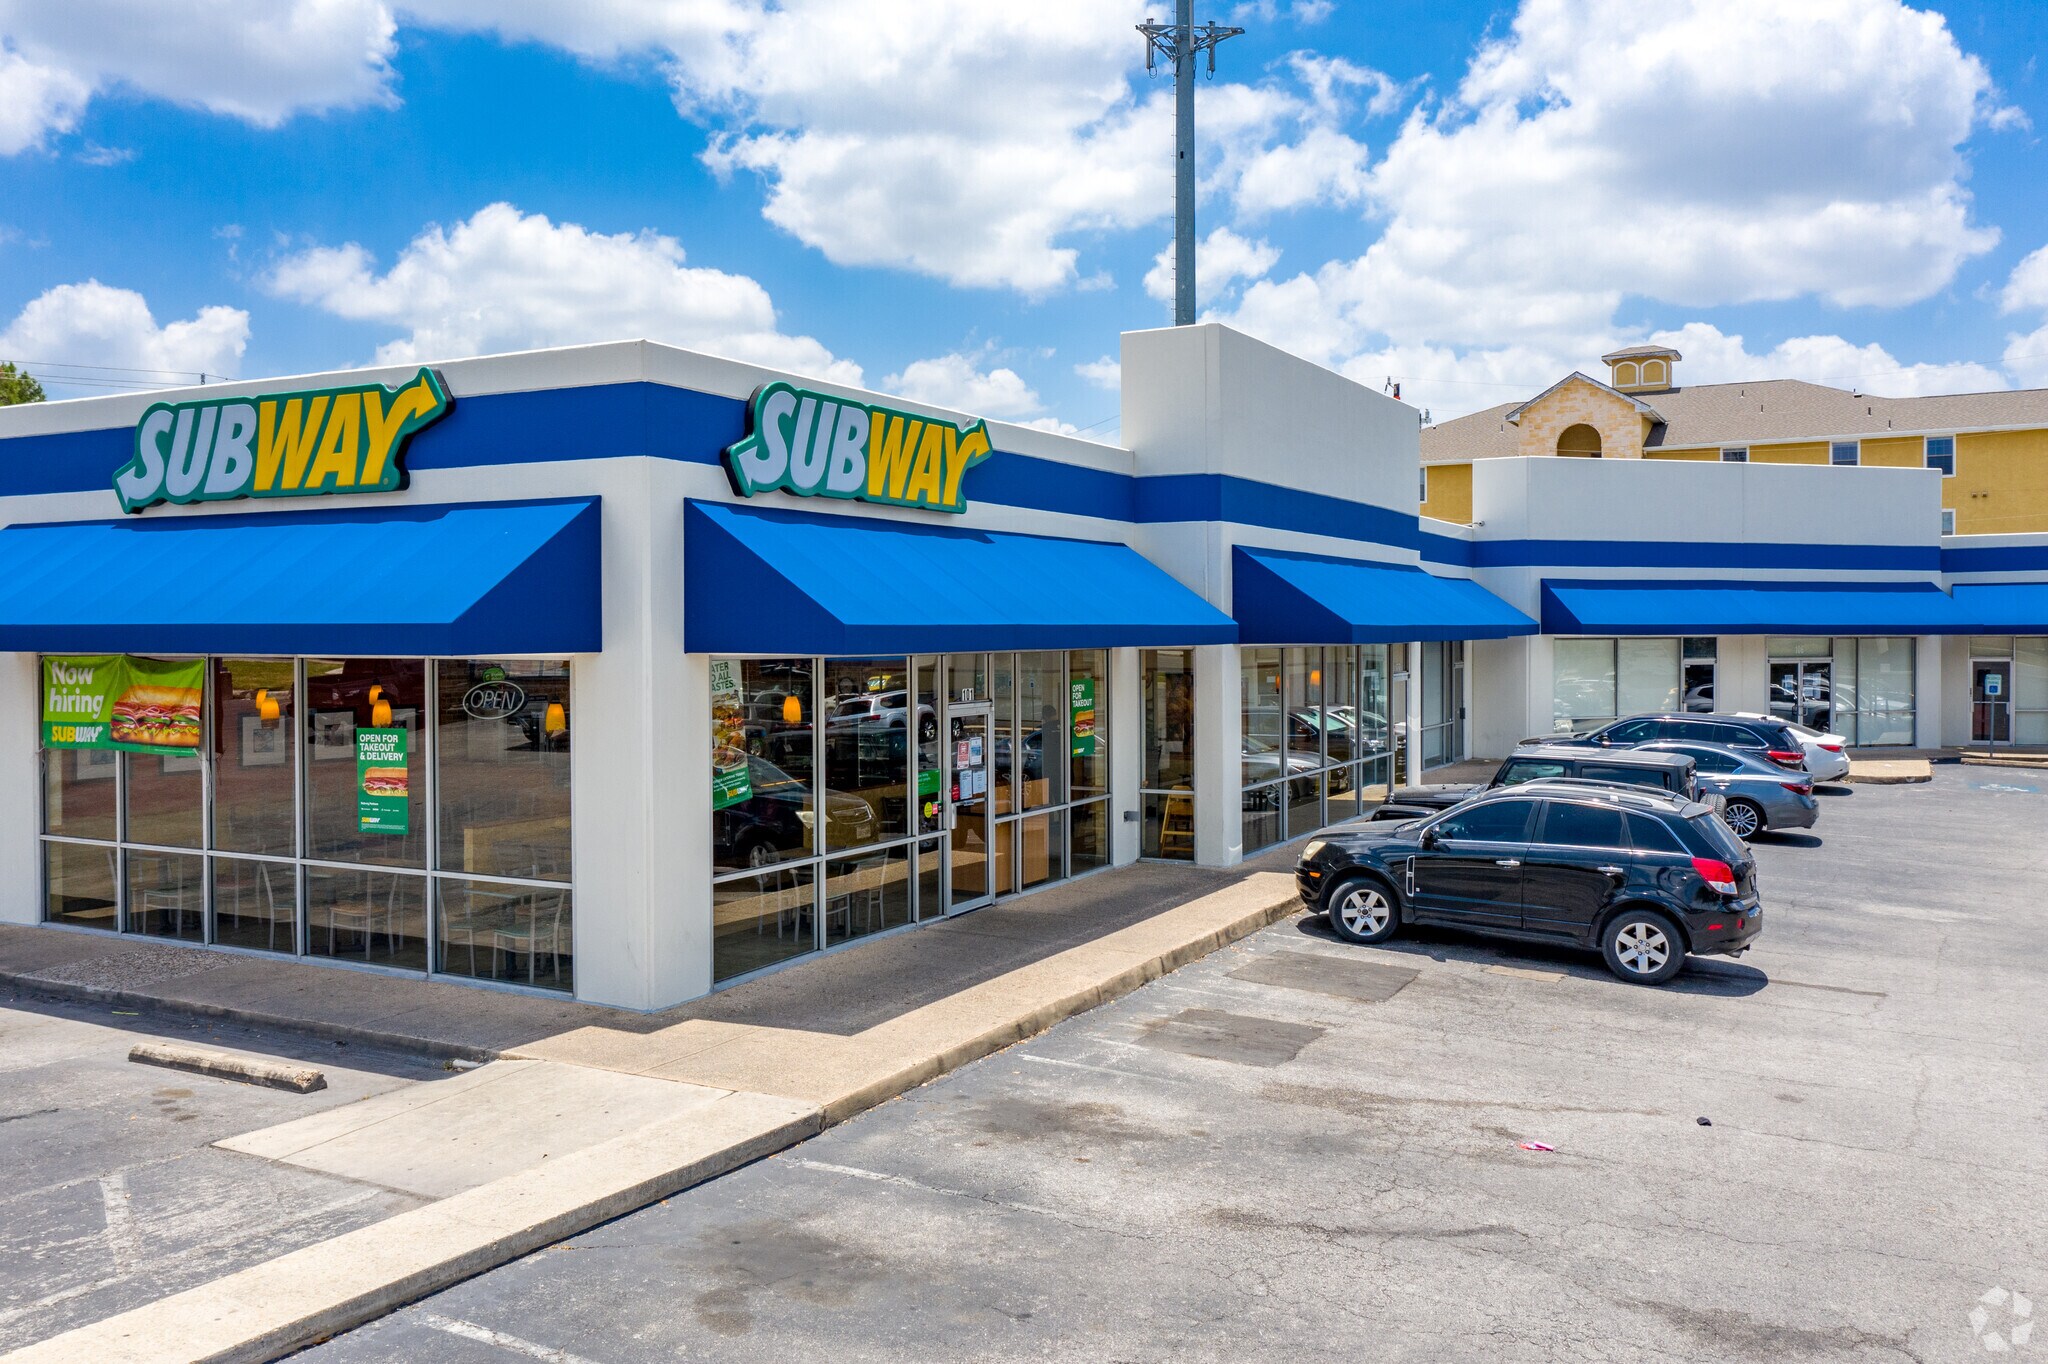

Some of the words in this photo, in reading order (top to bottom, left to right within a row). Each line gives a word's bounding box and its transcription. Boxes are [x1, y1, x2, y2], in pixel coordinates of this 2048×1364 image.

[117, 375, 438, 505] SUBWAY
[738, 390, 990, 506] SUBWAY
[51, 661, 94, 685] Now
[718, 671, 731, 681] ALL
[962, 687, 974, 701] 101
[1072, 684, 1085, 692] OPEN
[470, 690, 516, 709] OPEN
[1072, 692, 1082, 700] FOR
[50, 688, 104, 720] hiring
[1073, 699, 1092, 707] TAKEOUT
[52, 725, 103, 742] SUBWAY
[359, 734, 381, 742] OPEN
[382, 735, 398, 743] FOR
[360, 743, 395, 751] TAKEOUT
[360, 752, 365, 760] &
[366, 752, 404, 761] DELIVERY
